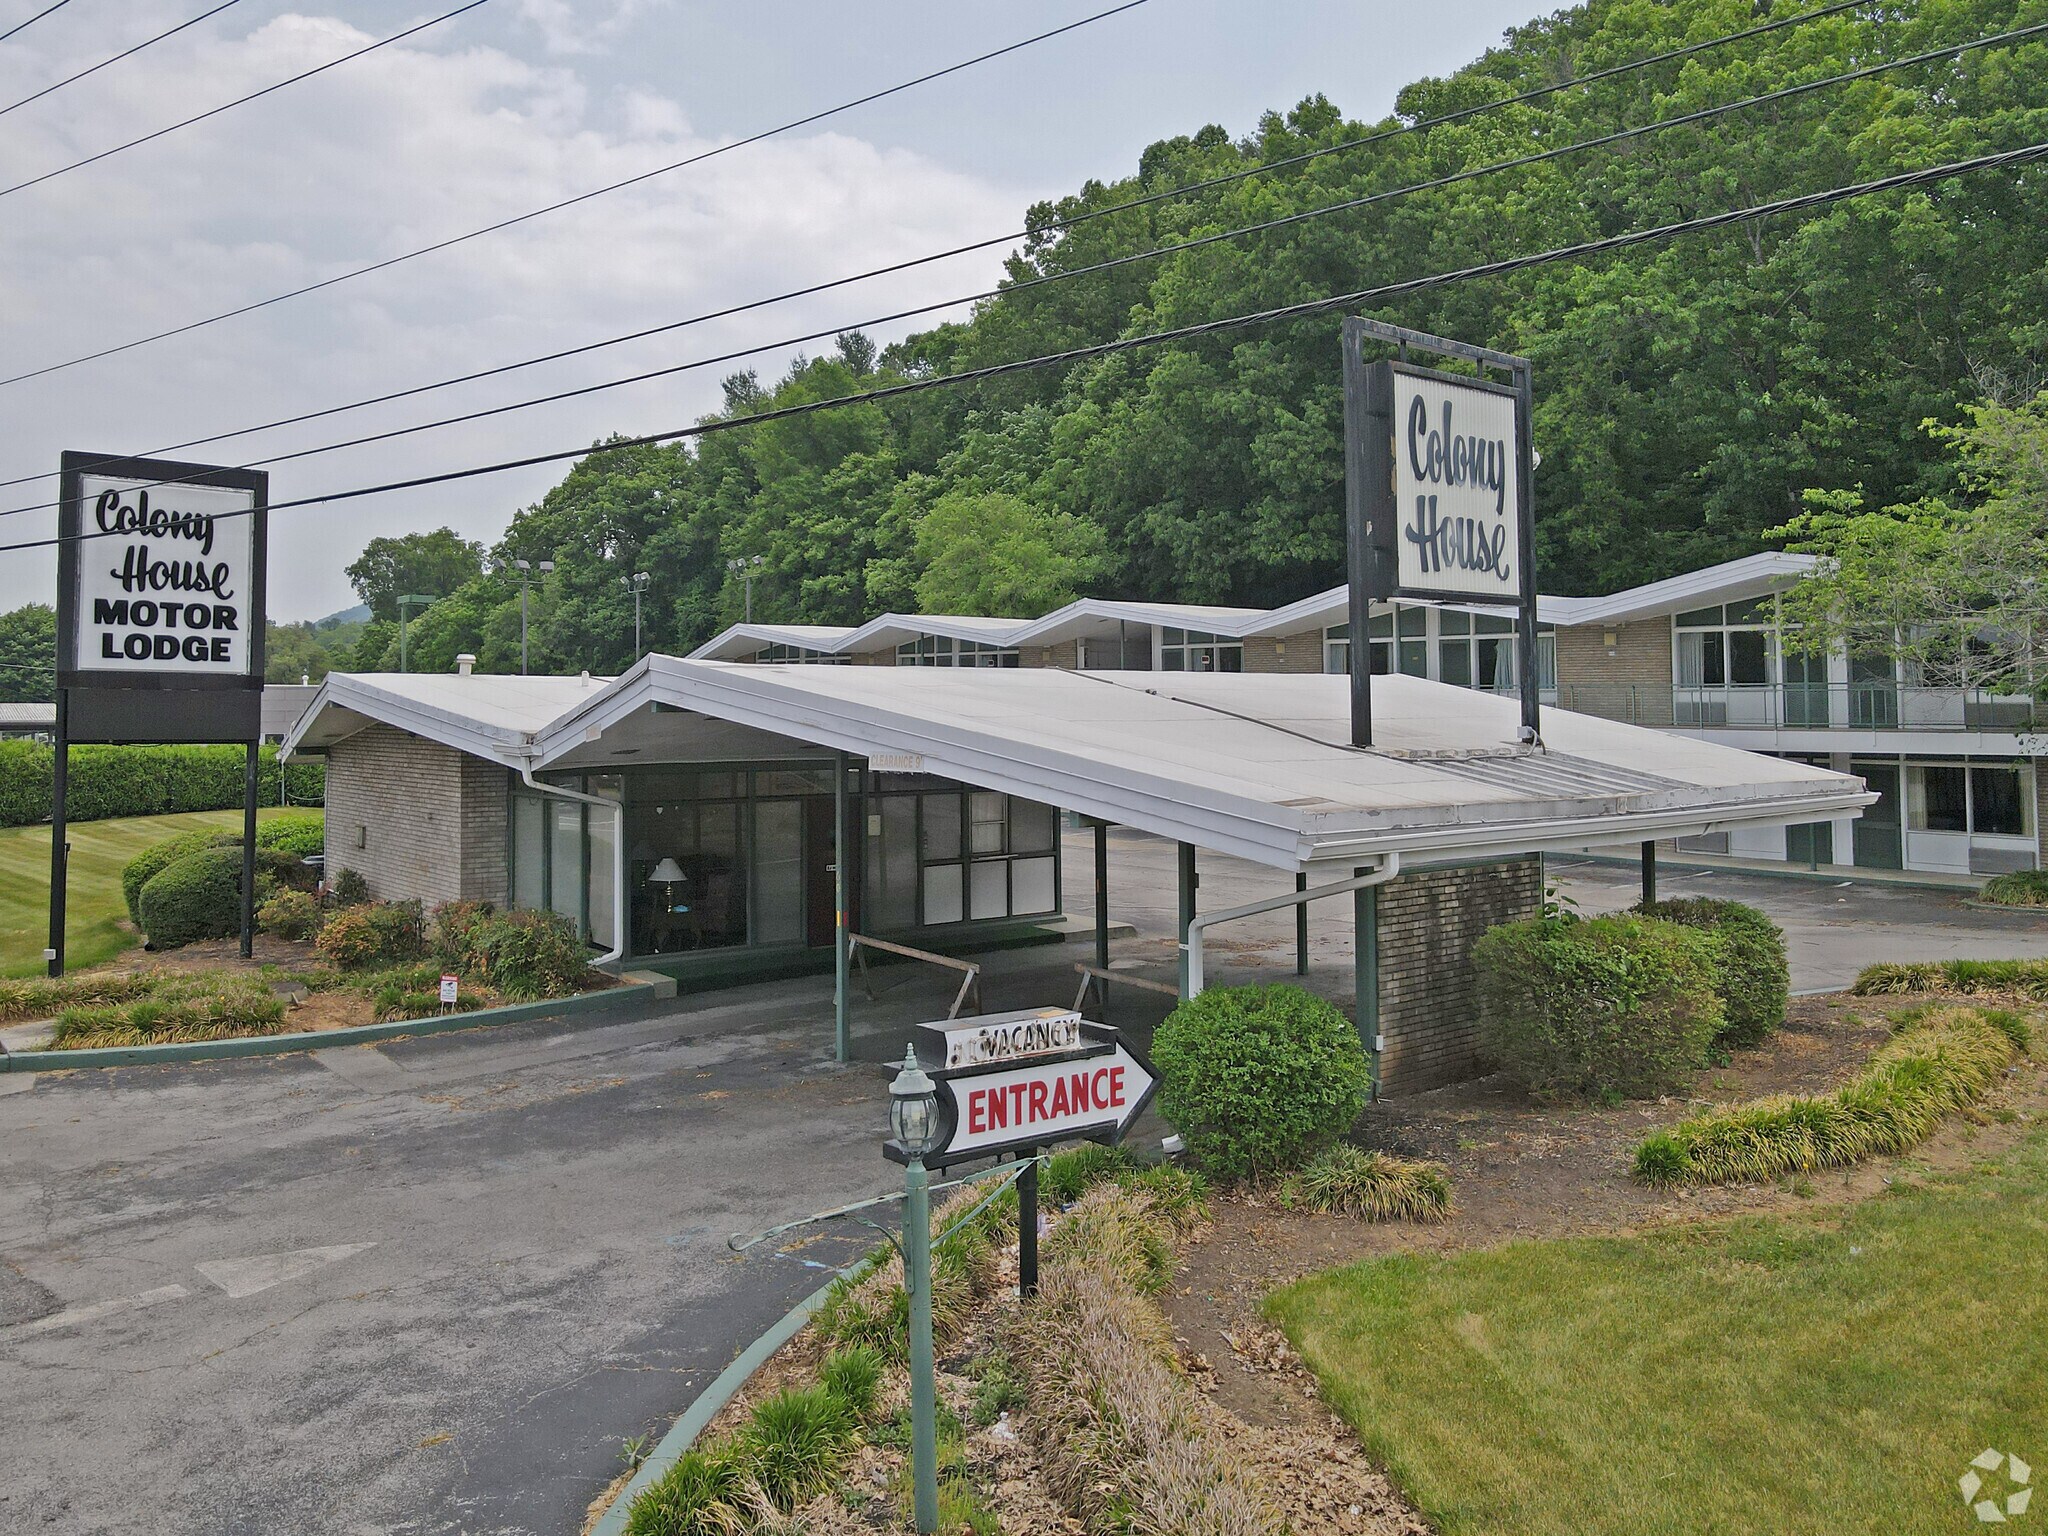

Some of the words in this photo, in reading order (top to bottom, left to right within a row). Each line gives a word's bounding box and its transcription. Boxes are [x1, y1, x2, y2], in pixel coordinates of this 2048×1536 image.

[1408, 394, 1504, 515] Colony
[96, 489, 213, 555] Colony
[1406, 495, 1509, 580] House
[110, 545, 234, 600] House
[94, 598, 239, 630] MOTOR
[101, 633, 231, 662] LODGE
[871, 754, 913, 768] CLEARANCE
[984, 1019, 1078, 1057] VACANCY
[968, 1066, 1125, 1135] ENTRANCE
